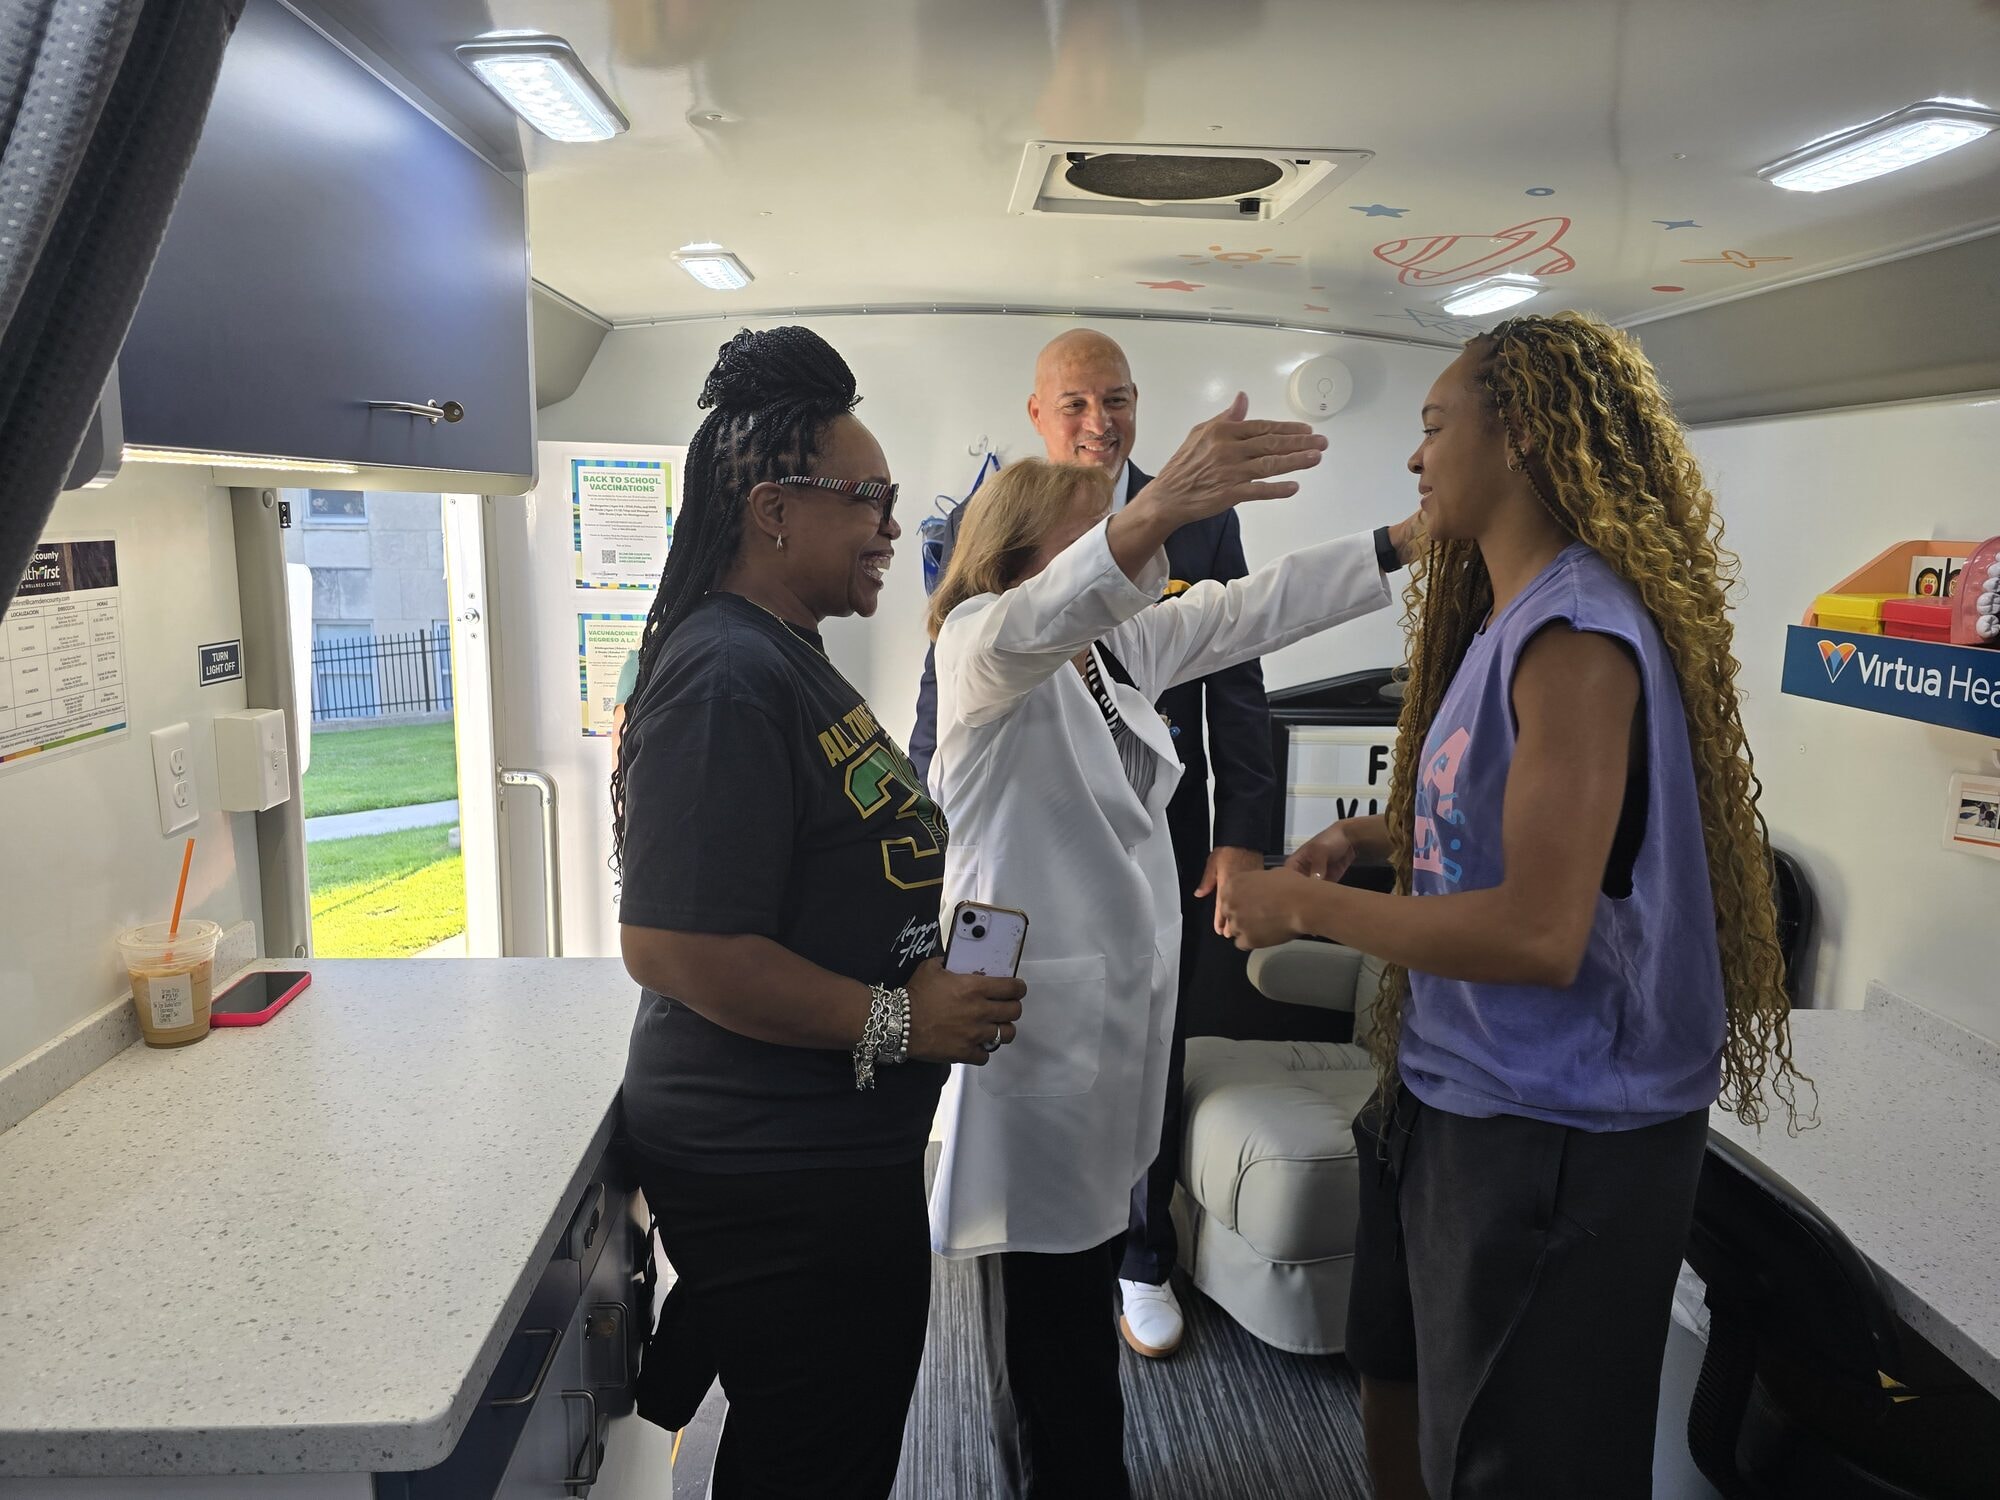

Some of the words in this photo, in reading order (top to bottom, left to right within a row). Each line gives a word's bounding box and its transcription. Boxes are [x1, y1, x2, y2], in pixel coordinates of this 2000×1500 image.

[583, 475, 608, 483] BACK
[623, 476, 661, 485] SCHOOL
[589, 484, 656, 492] VACCINATIONS
[212, 651, 229, 662] TURN
[206, 663, 224, 676] LIGHT
[224, 661, 236, 672] OFF
[1858, 651, 1943, 697] Virtua
